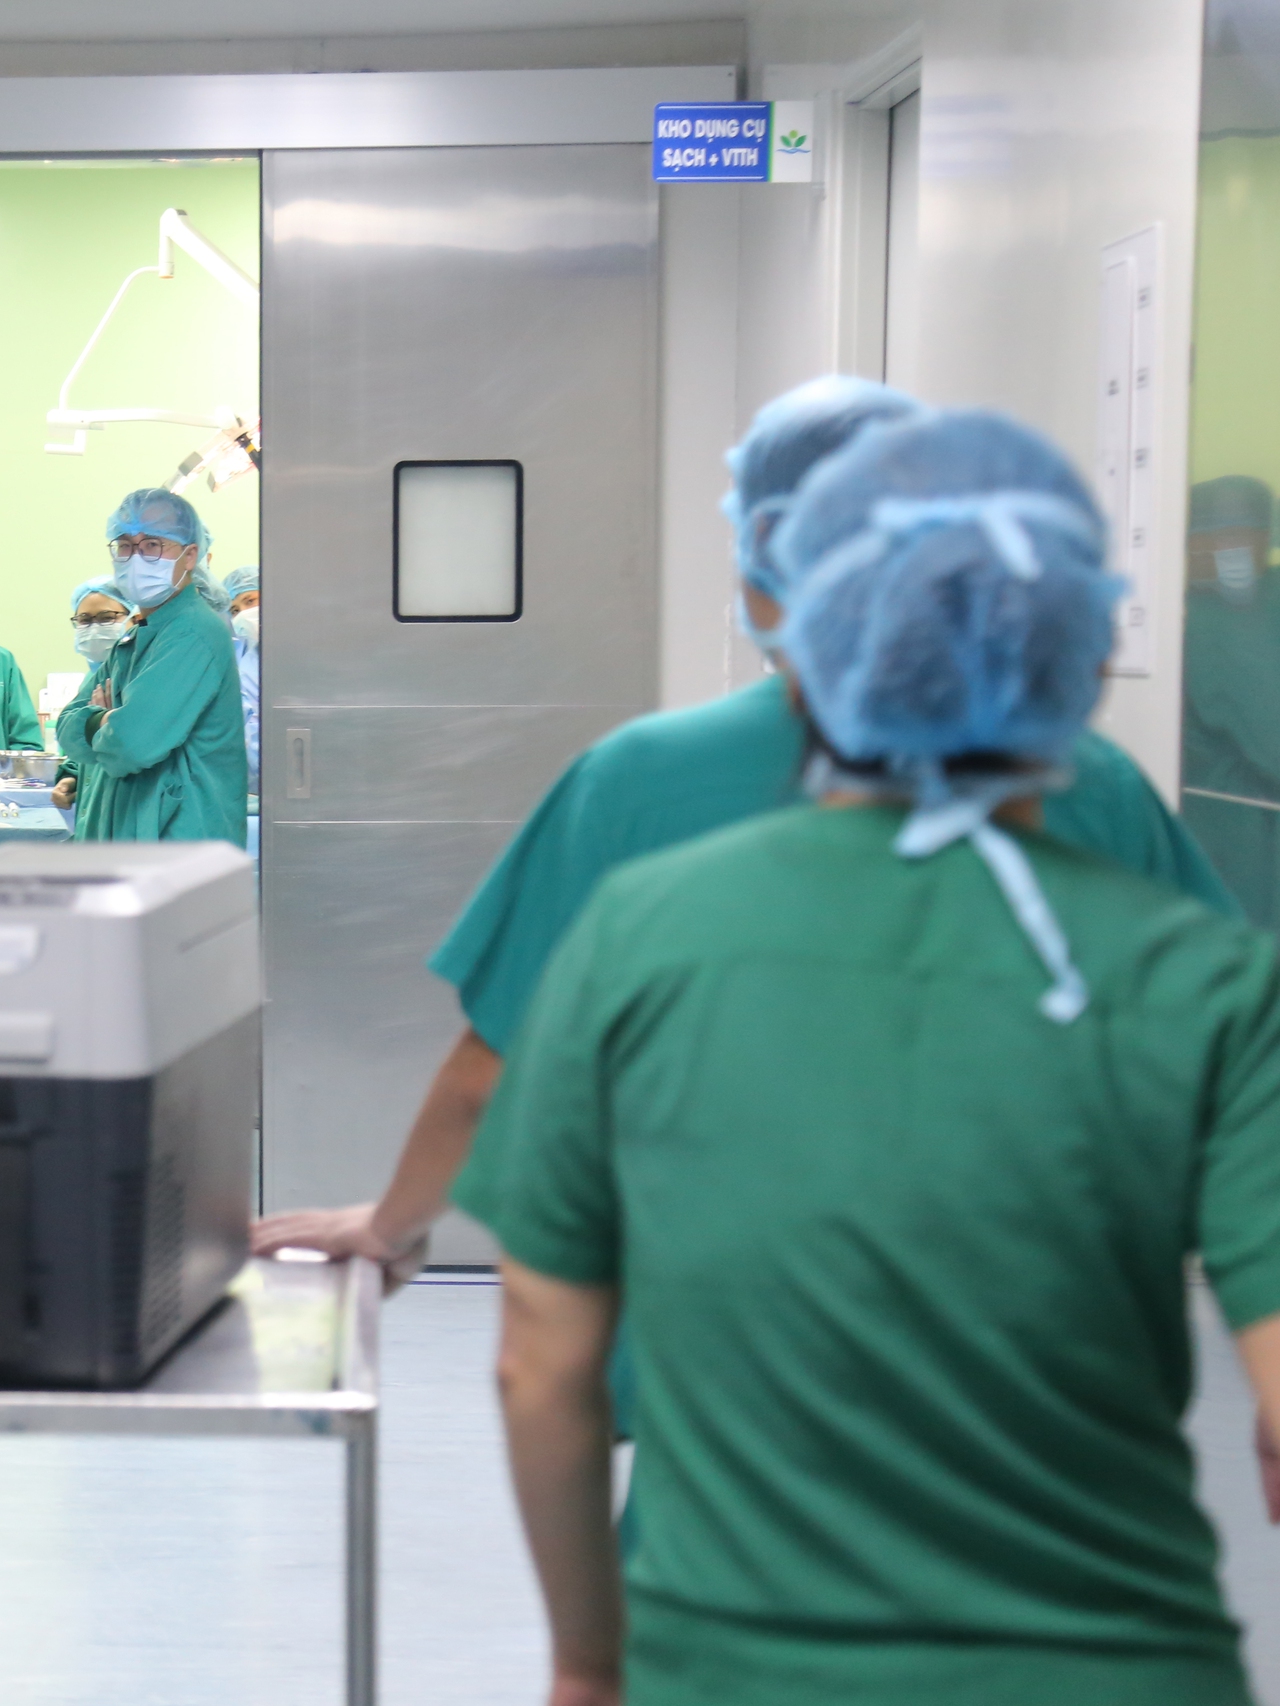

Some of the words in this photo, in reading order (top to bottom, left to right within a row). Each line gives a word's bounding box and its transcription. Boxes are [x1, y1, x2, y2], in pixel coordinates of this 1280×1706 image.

[657, 118, 692, 138] KHO
[694, 118, 740, 143] DỤNG
[742, 118, 767, 143] CỤ
[662, 147, 706, 172] SẠCH
[708, 153, 719, 167] +
[721, 147, 759, 167] VTTH
